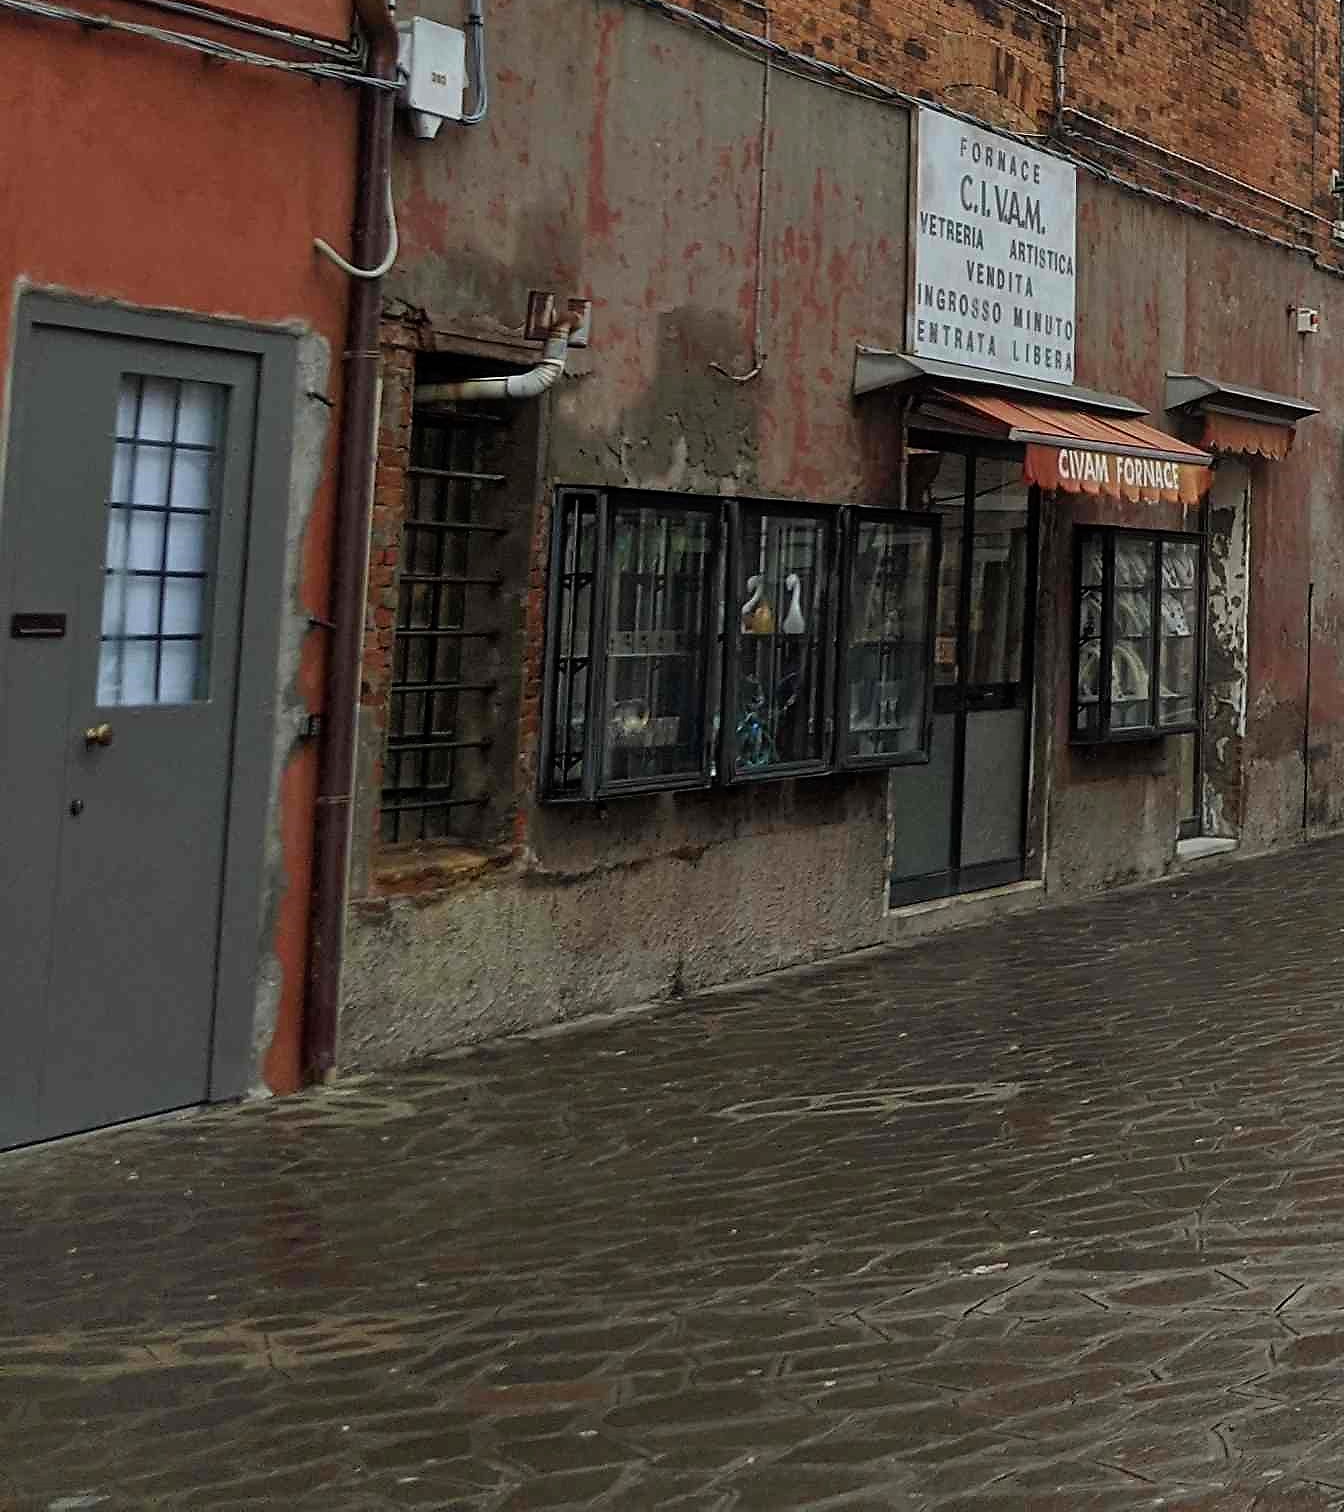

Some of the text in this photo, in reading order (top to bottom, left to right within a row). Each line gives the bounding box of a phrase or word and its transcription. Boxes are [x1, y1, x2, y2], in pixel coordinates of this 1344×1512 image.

[959, 137, 1041, 185] FORNACE
[919, 211, 1073, 276] VETRERIA ARTISTICA
[966, 260, 1033, 298] VENDITA
[918, 282, 1073, 341] INGROSSO MINUTO
[918, 319, 1073, 372] ENTRATA LIBERA
[1058, 448, 1180, 490] CIVAM FORNACE
